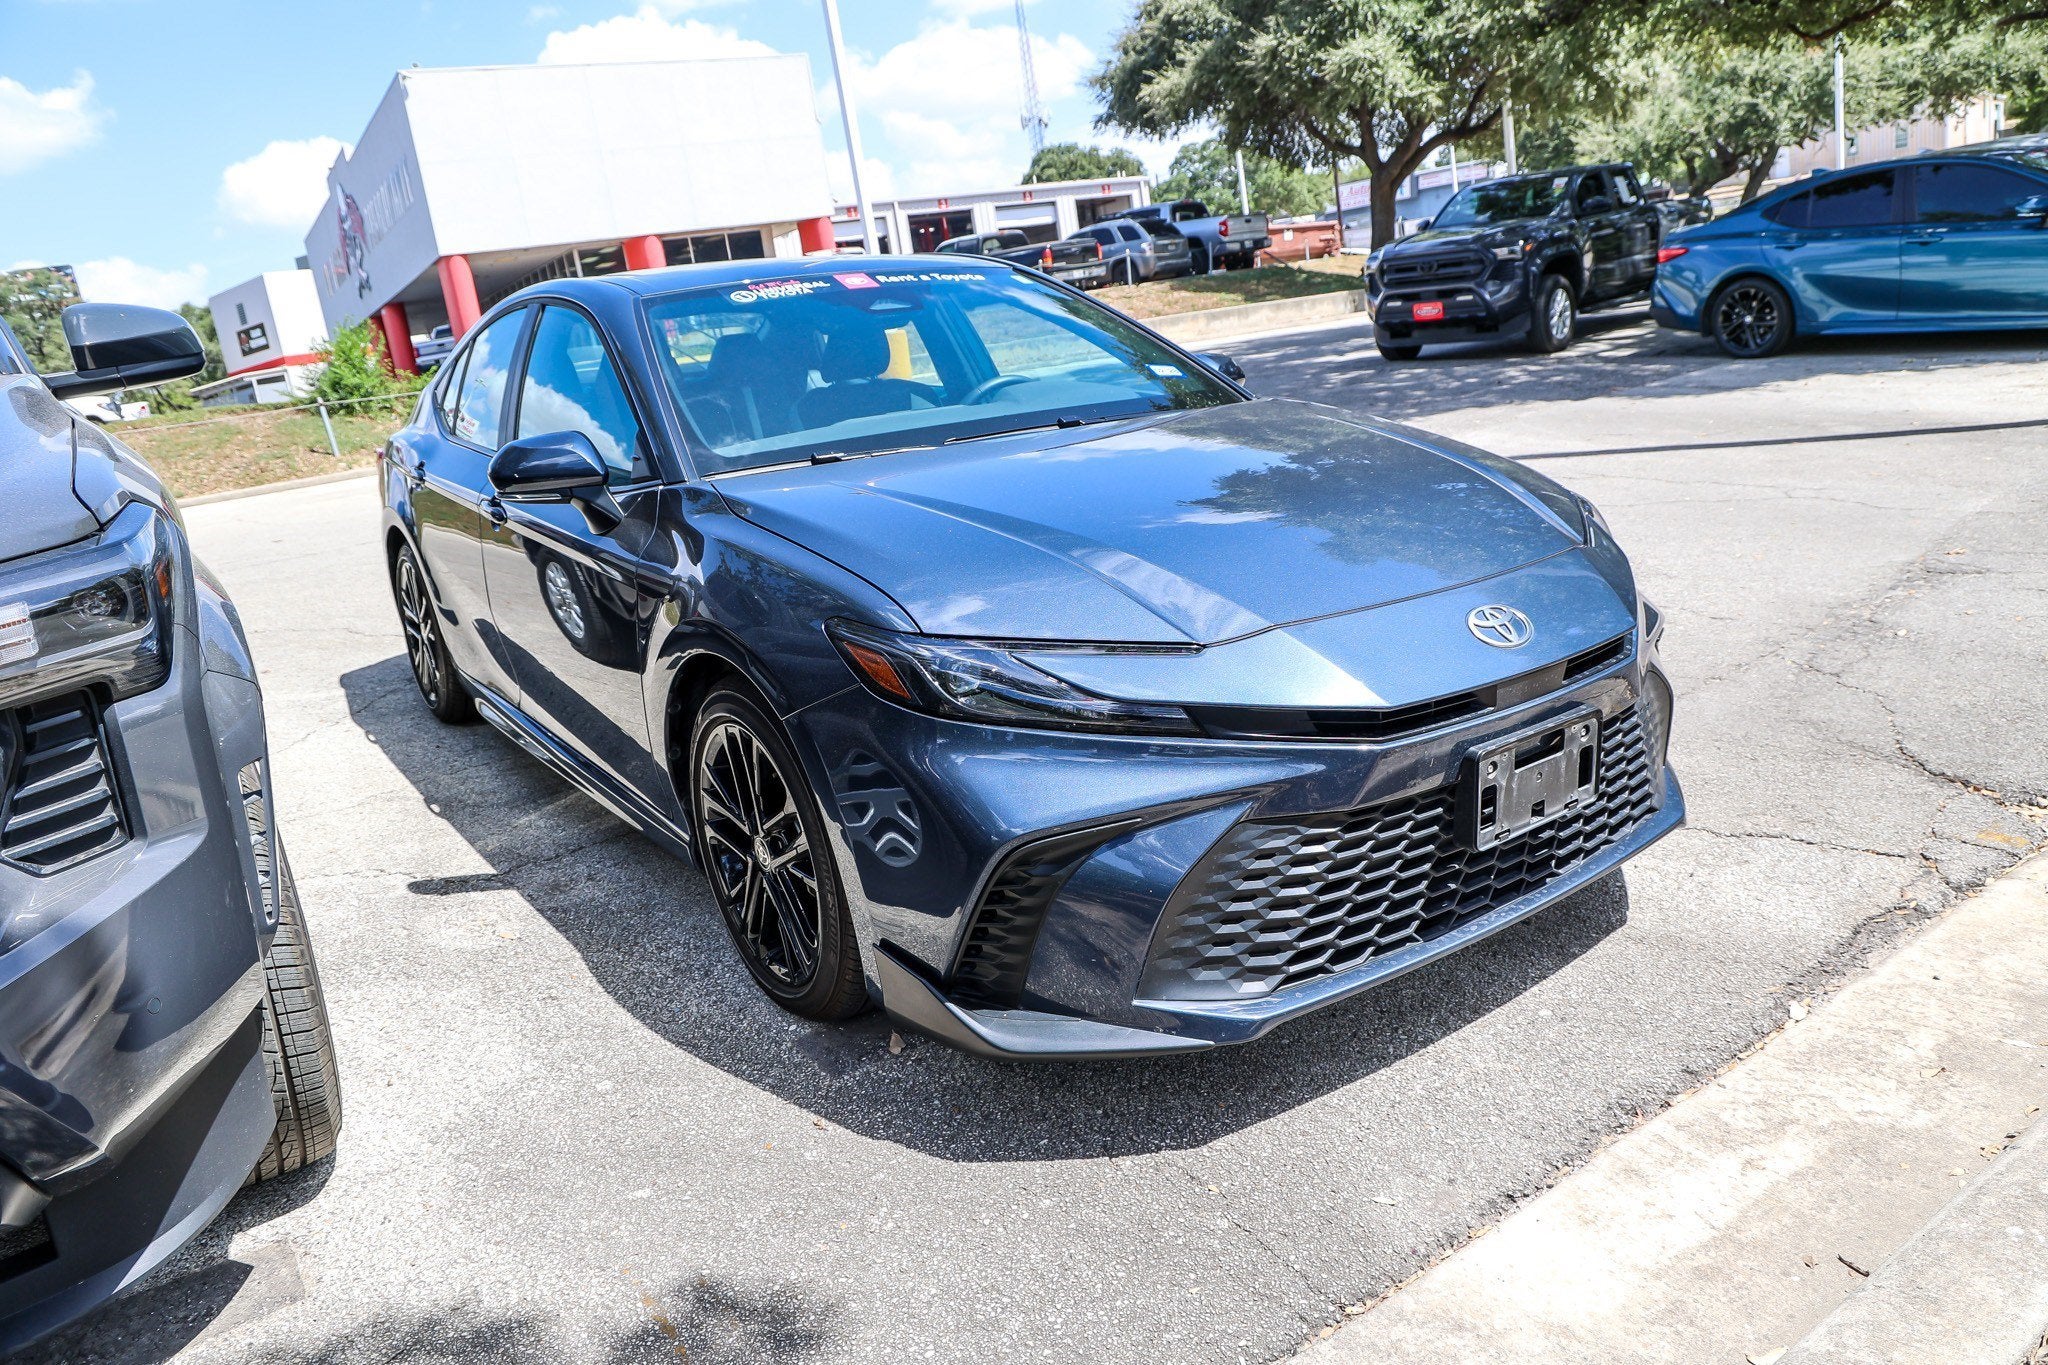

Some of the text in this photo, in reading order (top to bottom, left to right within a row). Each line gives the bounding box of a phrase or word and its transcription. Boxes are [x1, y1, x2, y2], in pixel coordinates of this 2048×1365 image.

[875, 274, 918, 283] Rent
[929, 273, 986, 281] Toyota
[753, 281, 830, 295] UNIVERSAL
[757, 285, 814, 299] TOYOTA
